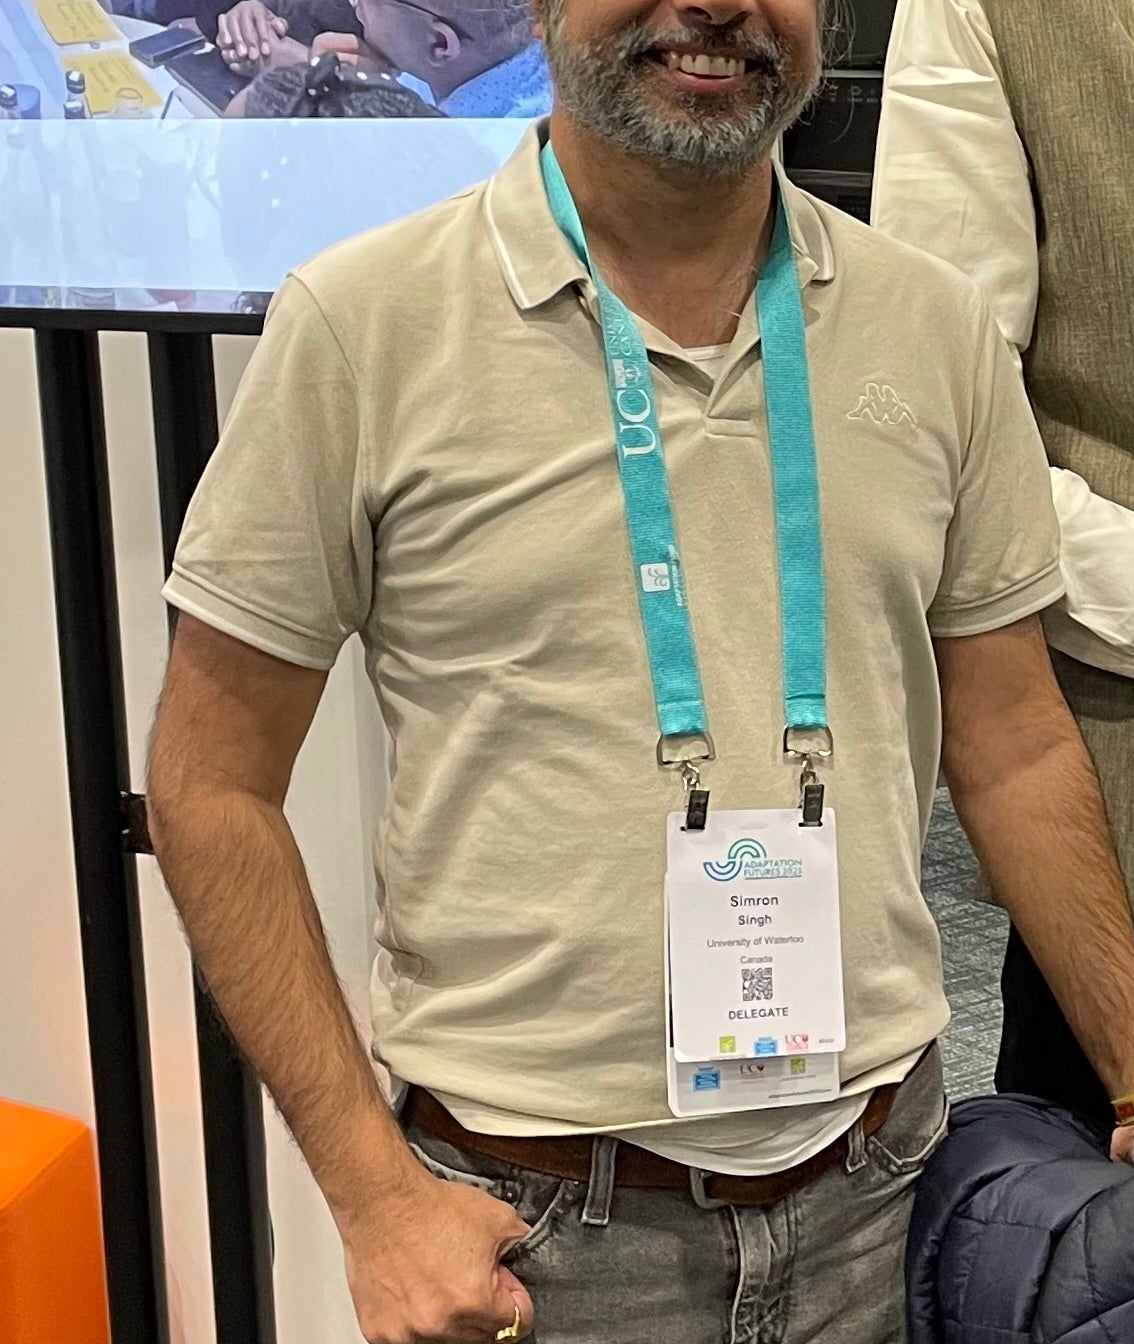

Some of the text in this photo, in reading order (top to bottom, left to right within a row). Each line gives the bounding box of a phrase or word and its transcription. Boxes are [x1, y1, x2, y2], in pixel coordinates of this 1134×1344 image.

[730, 895, 779, 907] Simron
[738, 914, 772, 928] Singh
[706, 938, 751, 949] University
[739, 955, 773, 965] Canada
[728, 1006, 790, 1020] DELEGATE
